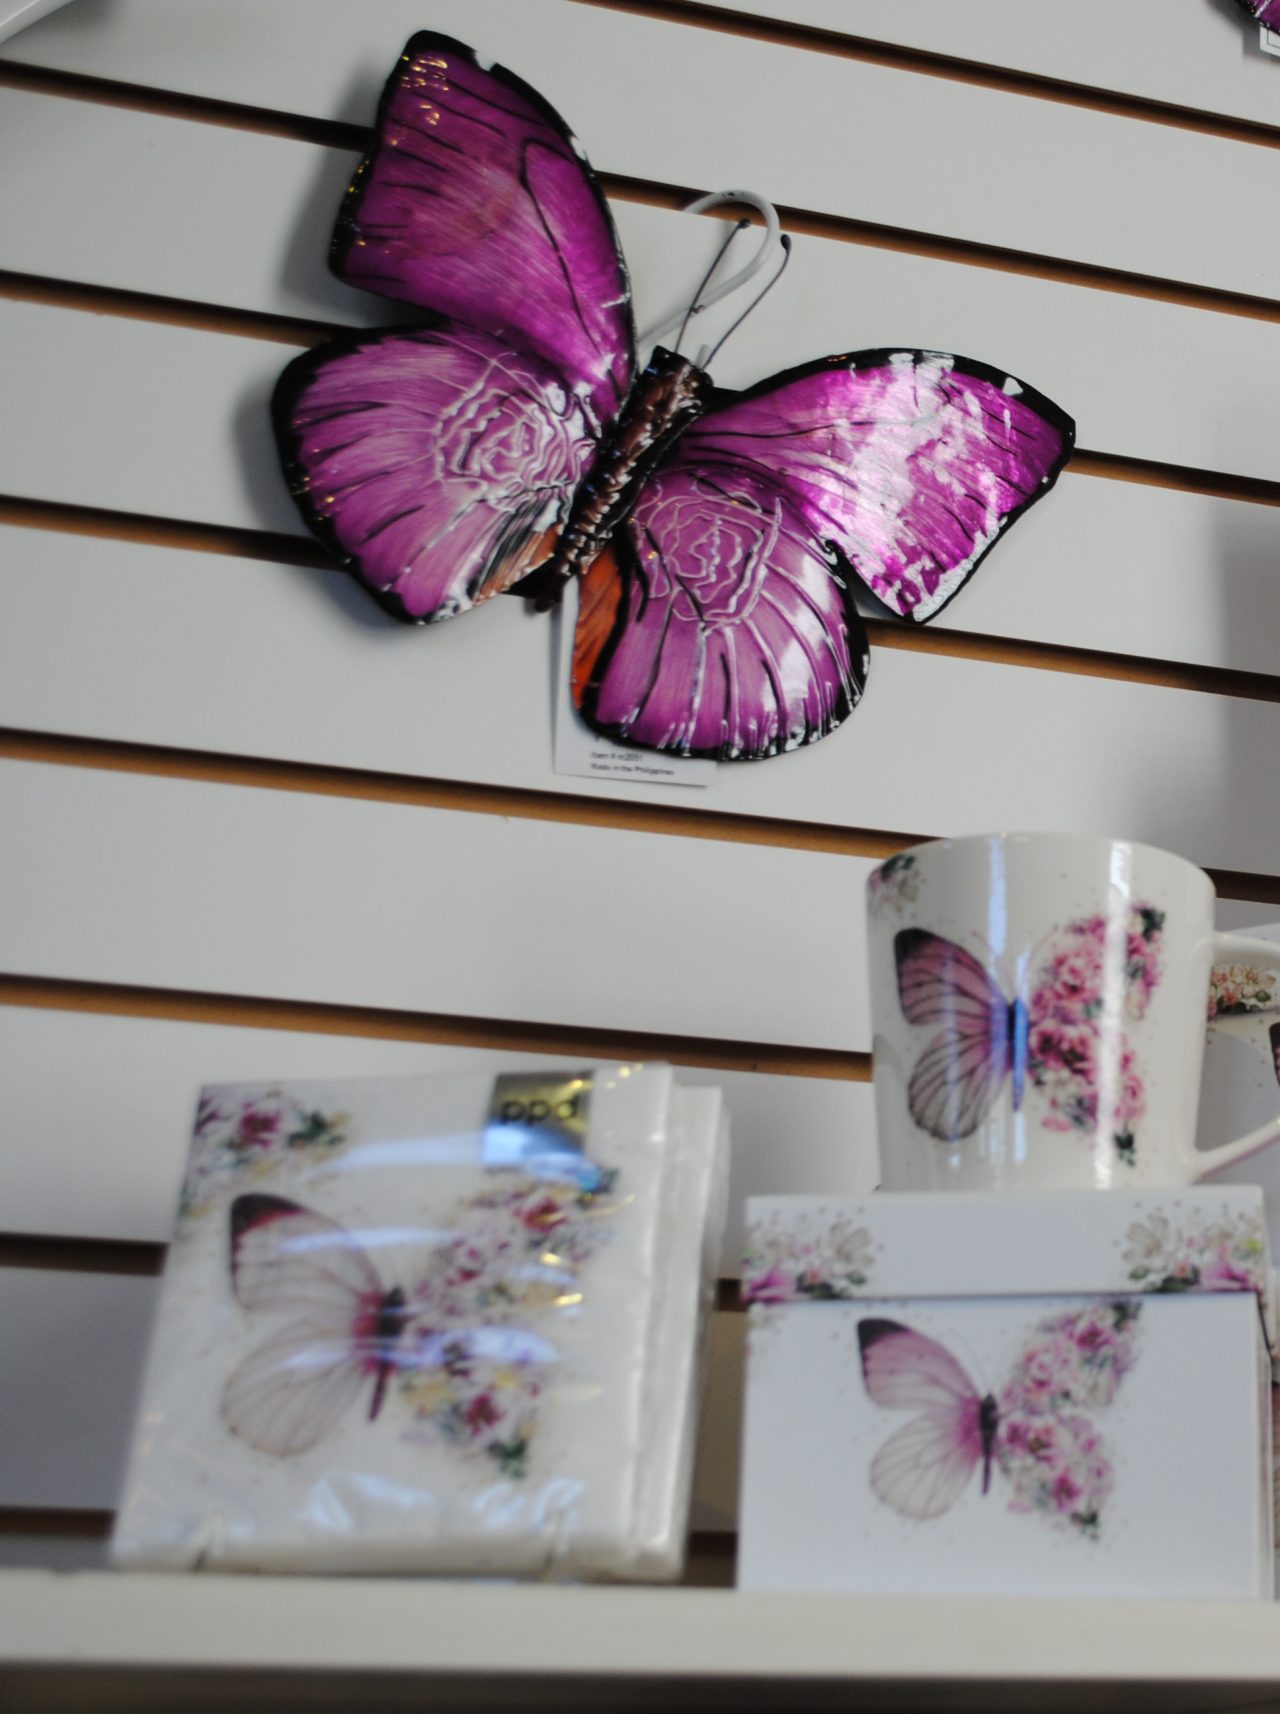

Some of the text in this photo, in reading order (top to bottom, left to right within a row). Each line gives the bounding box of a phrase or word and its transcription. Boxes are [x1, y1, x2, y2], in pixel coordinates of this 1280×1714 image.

[590, 762, 610, 771] Made
[621, 764, 632, 772] the
[634, 766, 675, 775] Philippines
[502, 1095, 579, 1124] ppd
